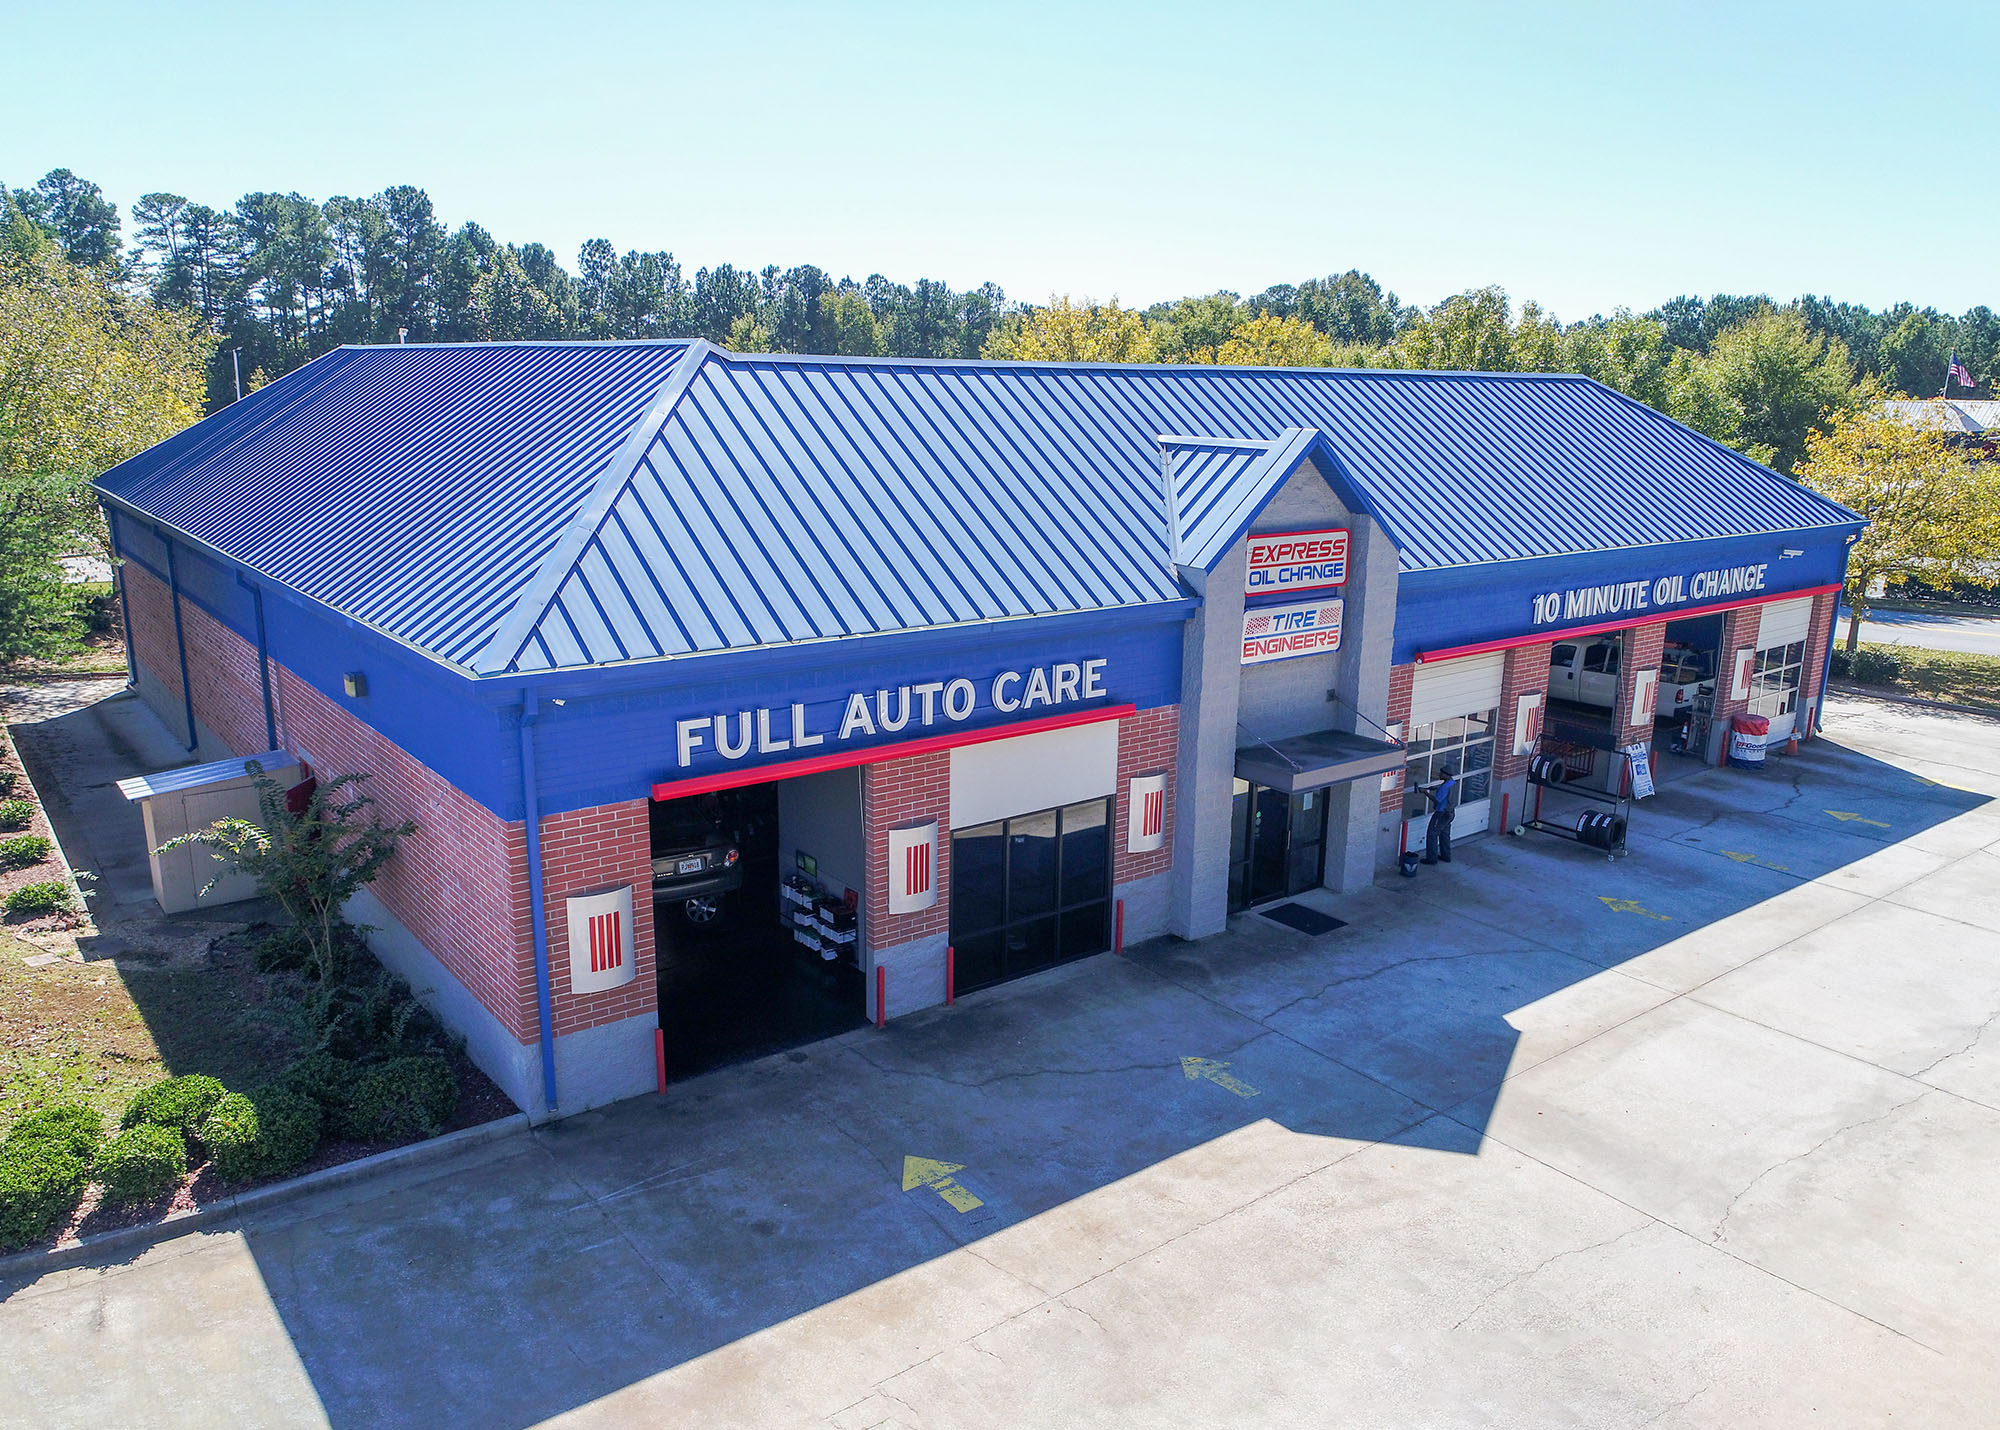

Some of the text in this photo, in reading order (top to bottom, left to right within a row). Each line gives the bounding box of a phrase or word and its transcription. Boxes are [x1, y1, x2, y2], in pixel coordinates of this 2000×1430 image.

[1250, 539, 1346, 564] EXPRESS
[1249, 562, 1344, 586] OIL CHANGE
[1532, 563, 1768, 624] 10 MINUTE OIL CHANGE
[1273, 610, 1317, 631] TIRE
[1243, 630, 1339, 658] ENGINEERS
[676, 658, 1107, 767] FULL AUTO CARE
[1469, 745, 1491, 797] AQUFINA
